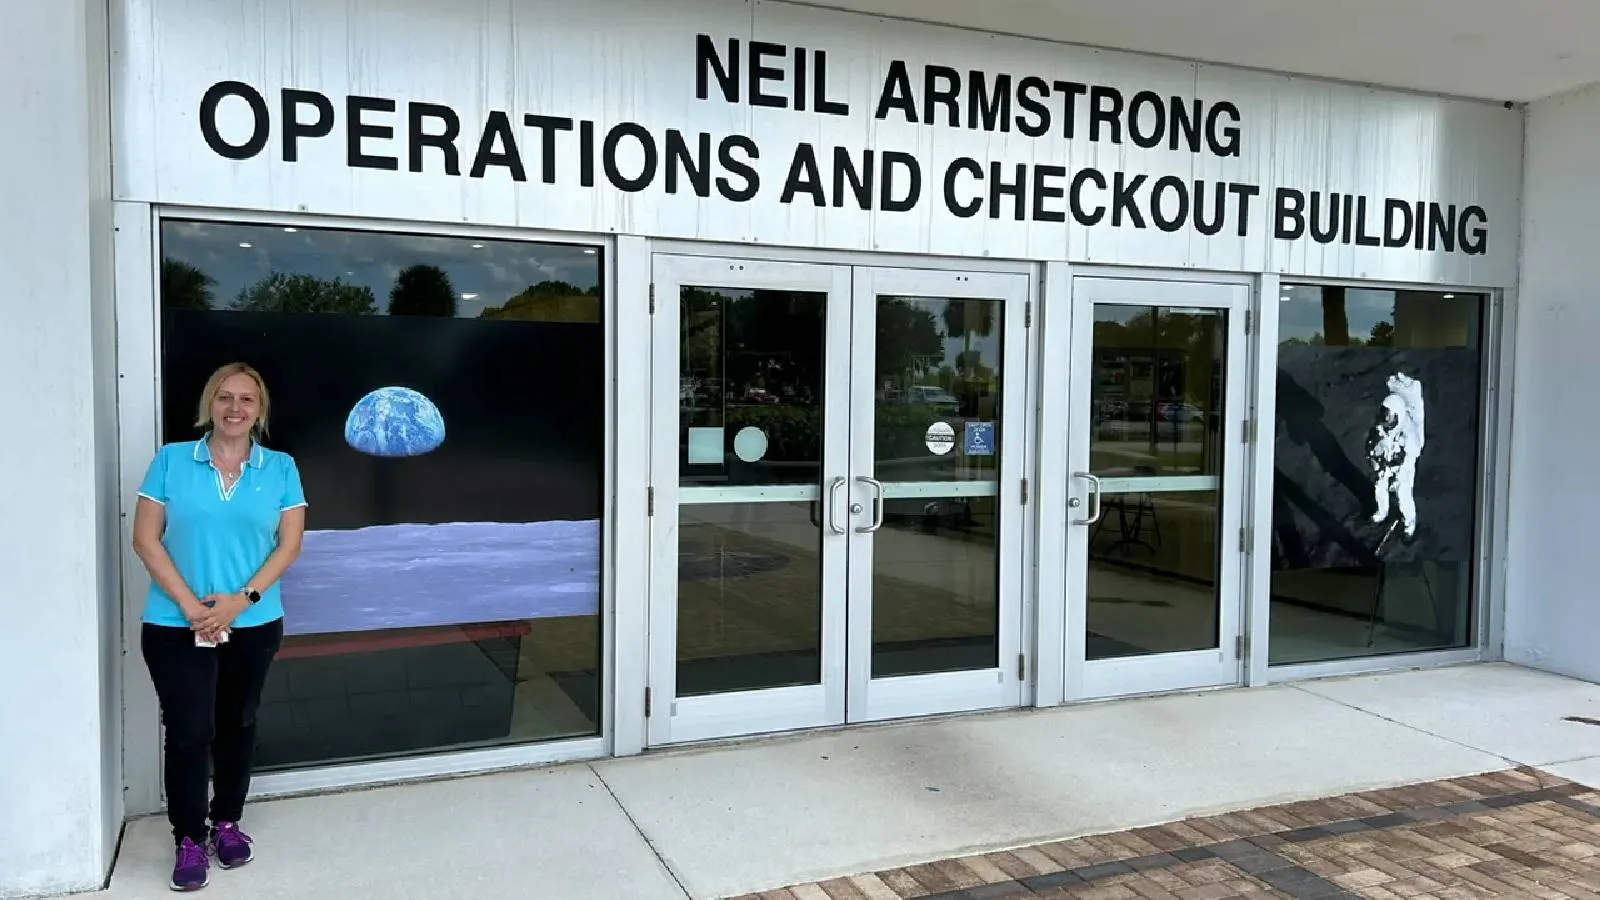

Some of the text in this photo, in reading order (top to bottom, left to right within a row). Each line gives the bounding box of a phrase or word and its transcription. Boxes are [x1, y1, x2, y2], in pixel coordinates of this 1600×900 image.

[199, 80, 1489, 256] OPERATIONS AND CHECKOUT BUILDING
[696, 33, 1241, 158] NEIL ARMSTRONG
